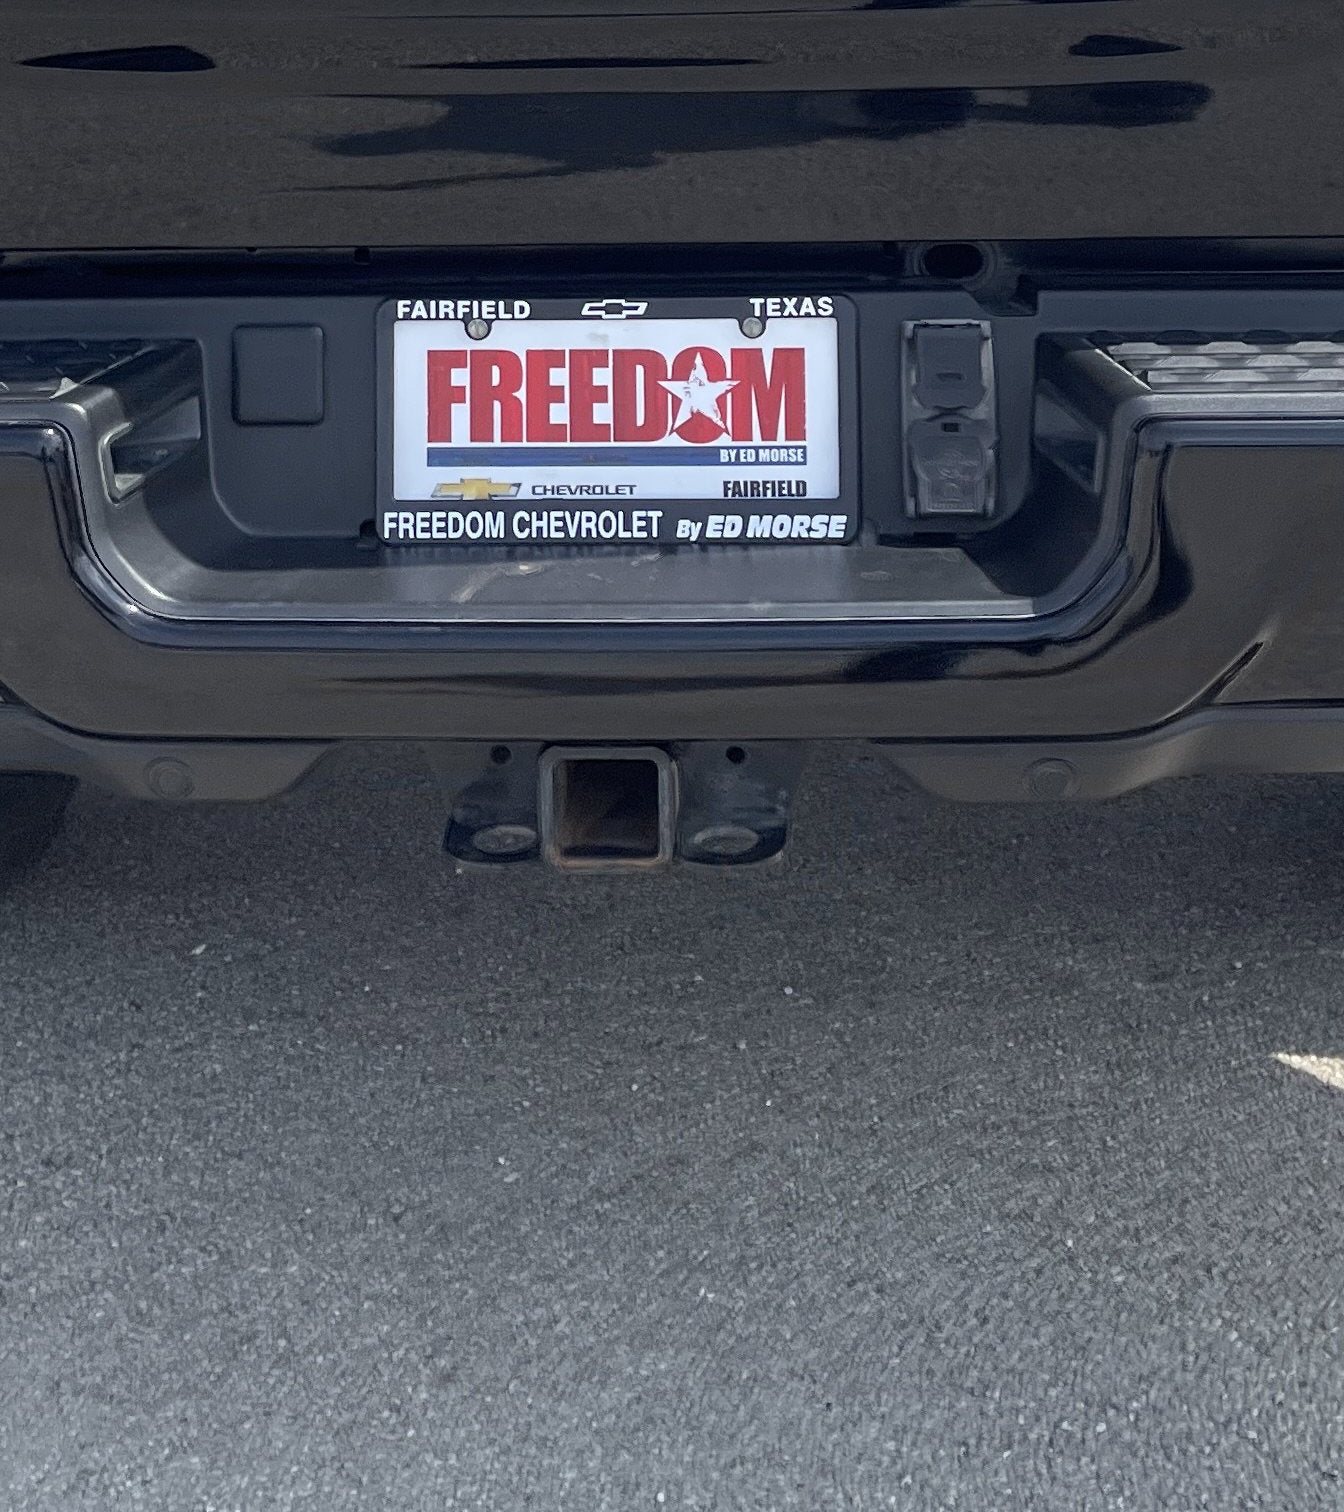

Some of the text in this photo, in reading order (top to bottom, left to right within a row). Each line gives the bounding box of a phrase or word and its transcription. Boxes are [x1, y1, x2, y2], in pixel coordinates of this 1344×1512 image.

[397, 300, 530, 319] FAIRFIELD
[750, 297, 833, 317] TEXAS
[427, 347, 807, 444] FREEDOM
[720, 449, 805, 463] BY ED MORSE
[531, 484, 637, 496] CHEVROLET
[723, 480, 807, 498] FAIRFIELD
[383, 510, 848, 540] FREEDOM CHEVROLET By ED MORSE
